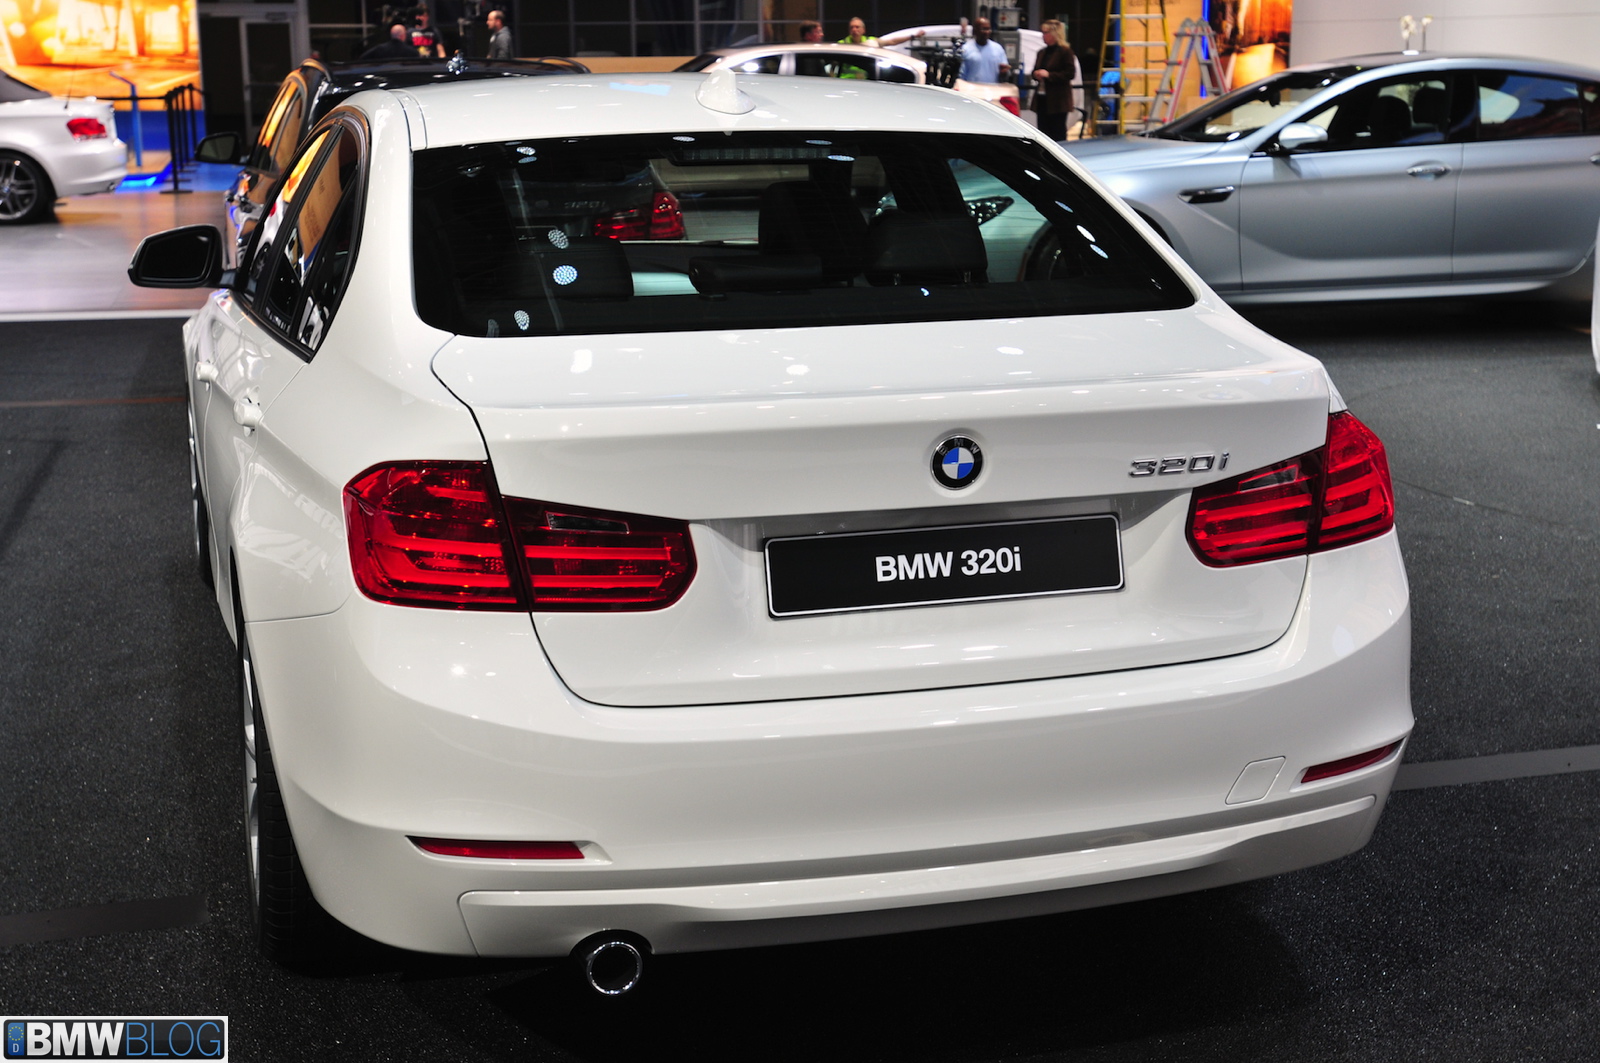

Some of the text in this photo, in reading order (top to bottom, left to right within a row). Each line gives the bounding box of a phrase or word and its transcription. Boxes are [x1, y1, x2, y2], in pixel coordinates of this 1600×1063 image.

[937, 438, 980, 456] BMW
[1128, 452, 1230, 478] 320i
[875, 546, 1022, 582] BMW 320i
